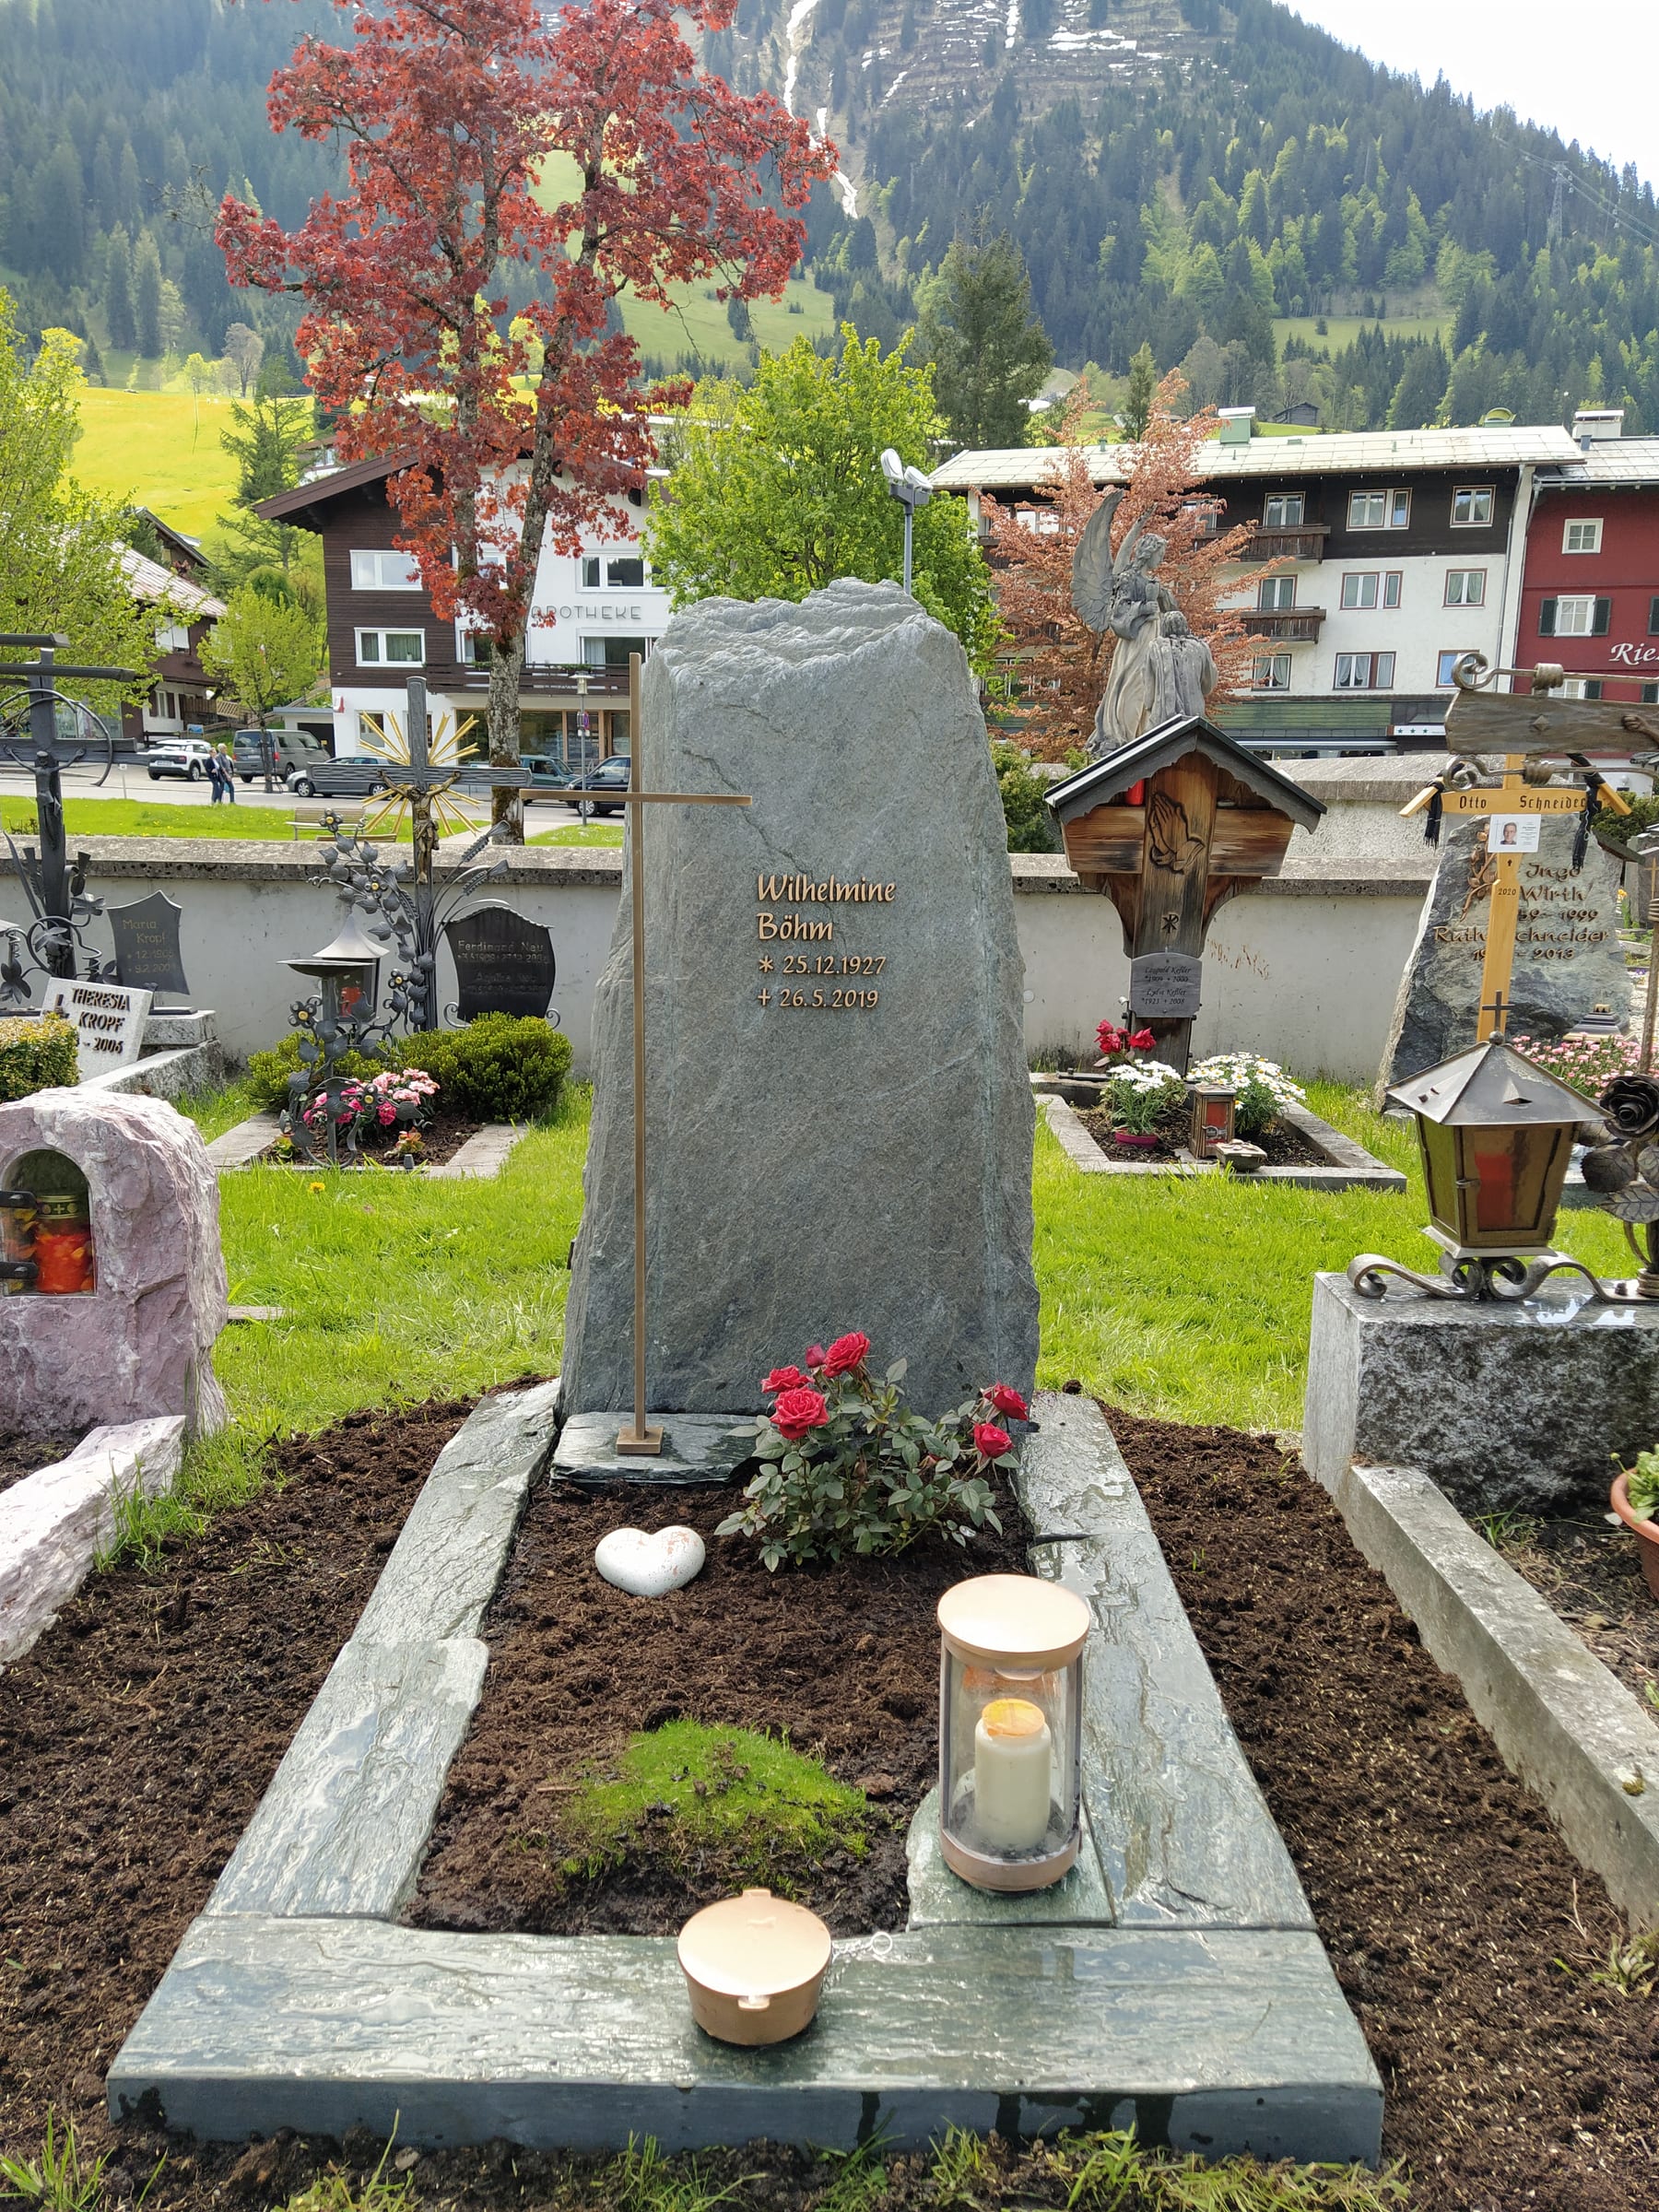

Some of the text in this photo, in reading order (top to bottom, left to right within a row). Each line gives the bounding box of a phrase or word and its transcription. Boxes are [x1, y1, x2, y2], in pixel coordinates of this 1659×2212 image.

[1608, 642, 1659, 665] Rie
[1459, 795, 1487, 809] Otto
[758, 874, 896, 902] Wilhelmine
[1498, 888, 1516, 897] 2020
[1520, 885, 1585, 901] Wirth
[1559, 909, 1598, 922] 1999
[757, 912, 833, 940] Böhm
[1433, 926, 1608, 943] Ruth chneider
[1534, 948, 1575, 960] 2013
[783, 955, 886, 974] 25.12.1927
[73, 988, 130, 1011] THERESIA
[780, 988, 878, 1007] 26.5.2019
[79, 1012, 125, 1032] KROPF
[94, 1037, 124, 1053] 2006
